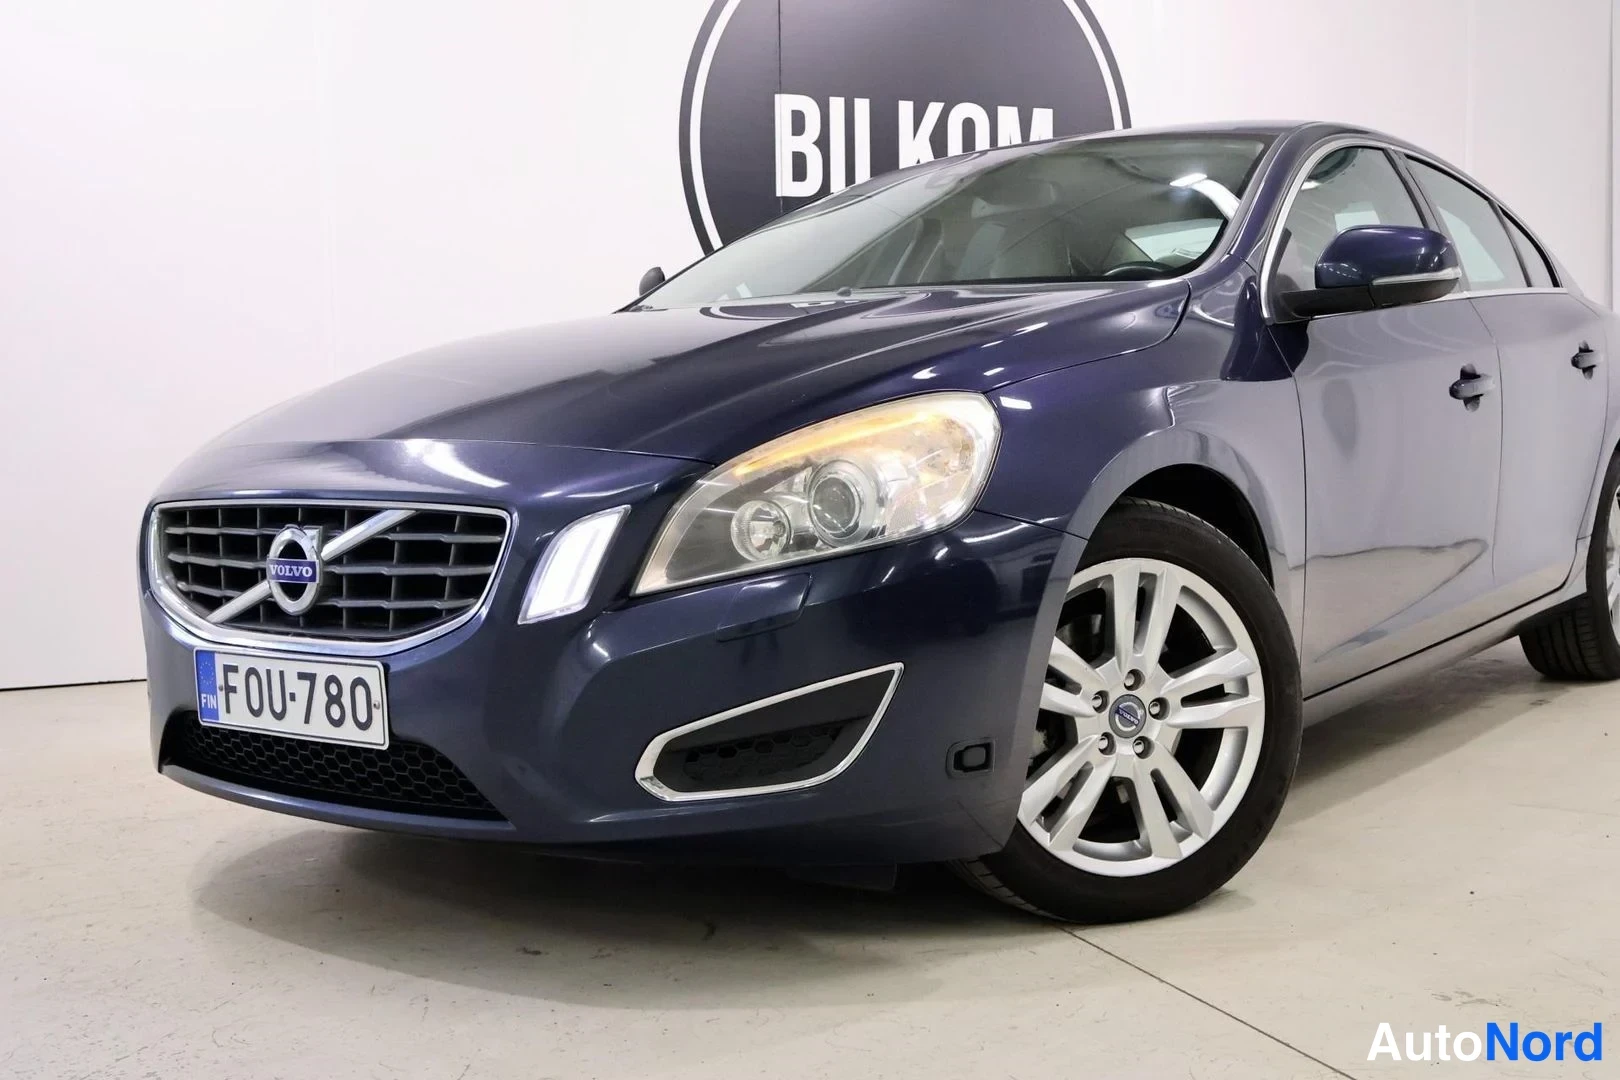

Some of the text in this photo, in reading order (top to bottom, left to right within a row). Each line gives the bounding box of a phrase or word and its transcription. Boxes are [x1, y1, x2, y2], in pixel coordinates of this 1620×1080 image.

[270, 564, 313, 577] VOLVO
[201, 693, 217, 709] FIN
[222, 664, 373, 731] FOU-780
